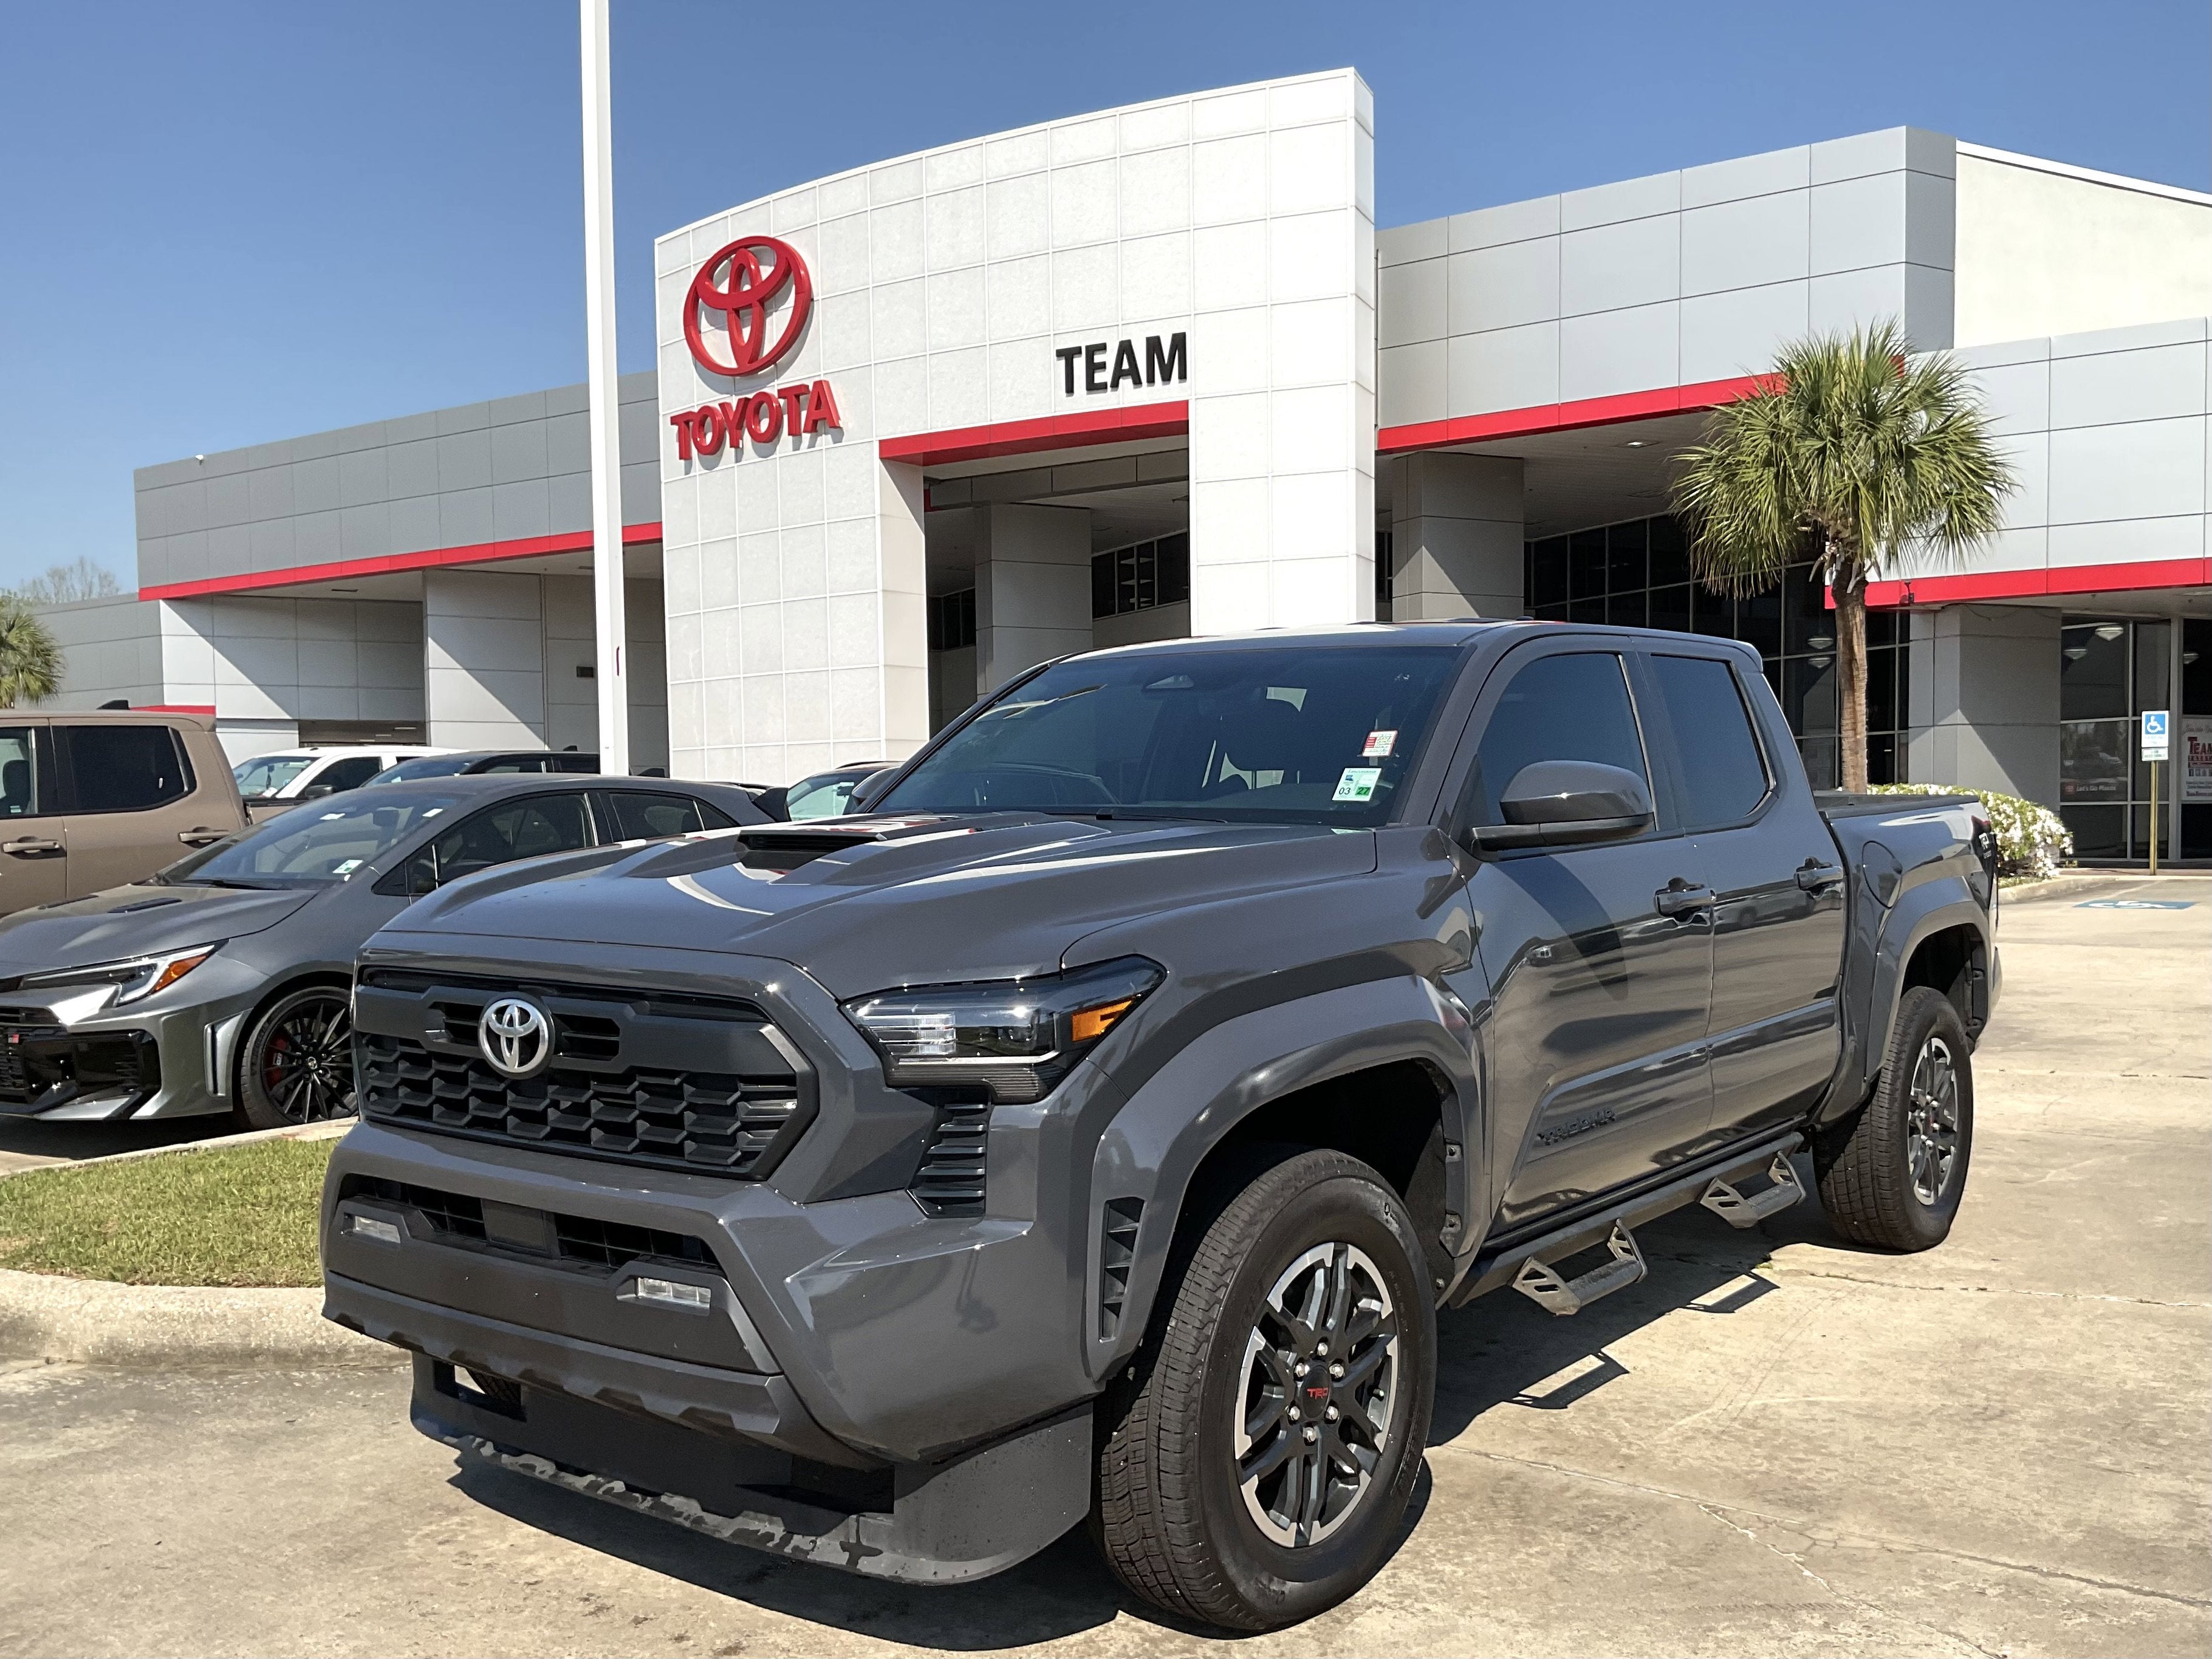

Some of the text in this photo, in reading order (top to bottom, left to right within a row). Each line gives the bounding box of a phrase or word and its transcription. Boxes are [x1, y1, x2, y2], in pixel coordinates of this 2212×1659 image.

[1056, 332, 1188, 395] TEAM
[671, 379, 841, 461] TOYOTA
[1338, 787, 1351, 795] 03
[1307, 1387, 1328, 1400] TRD
